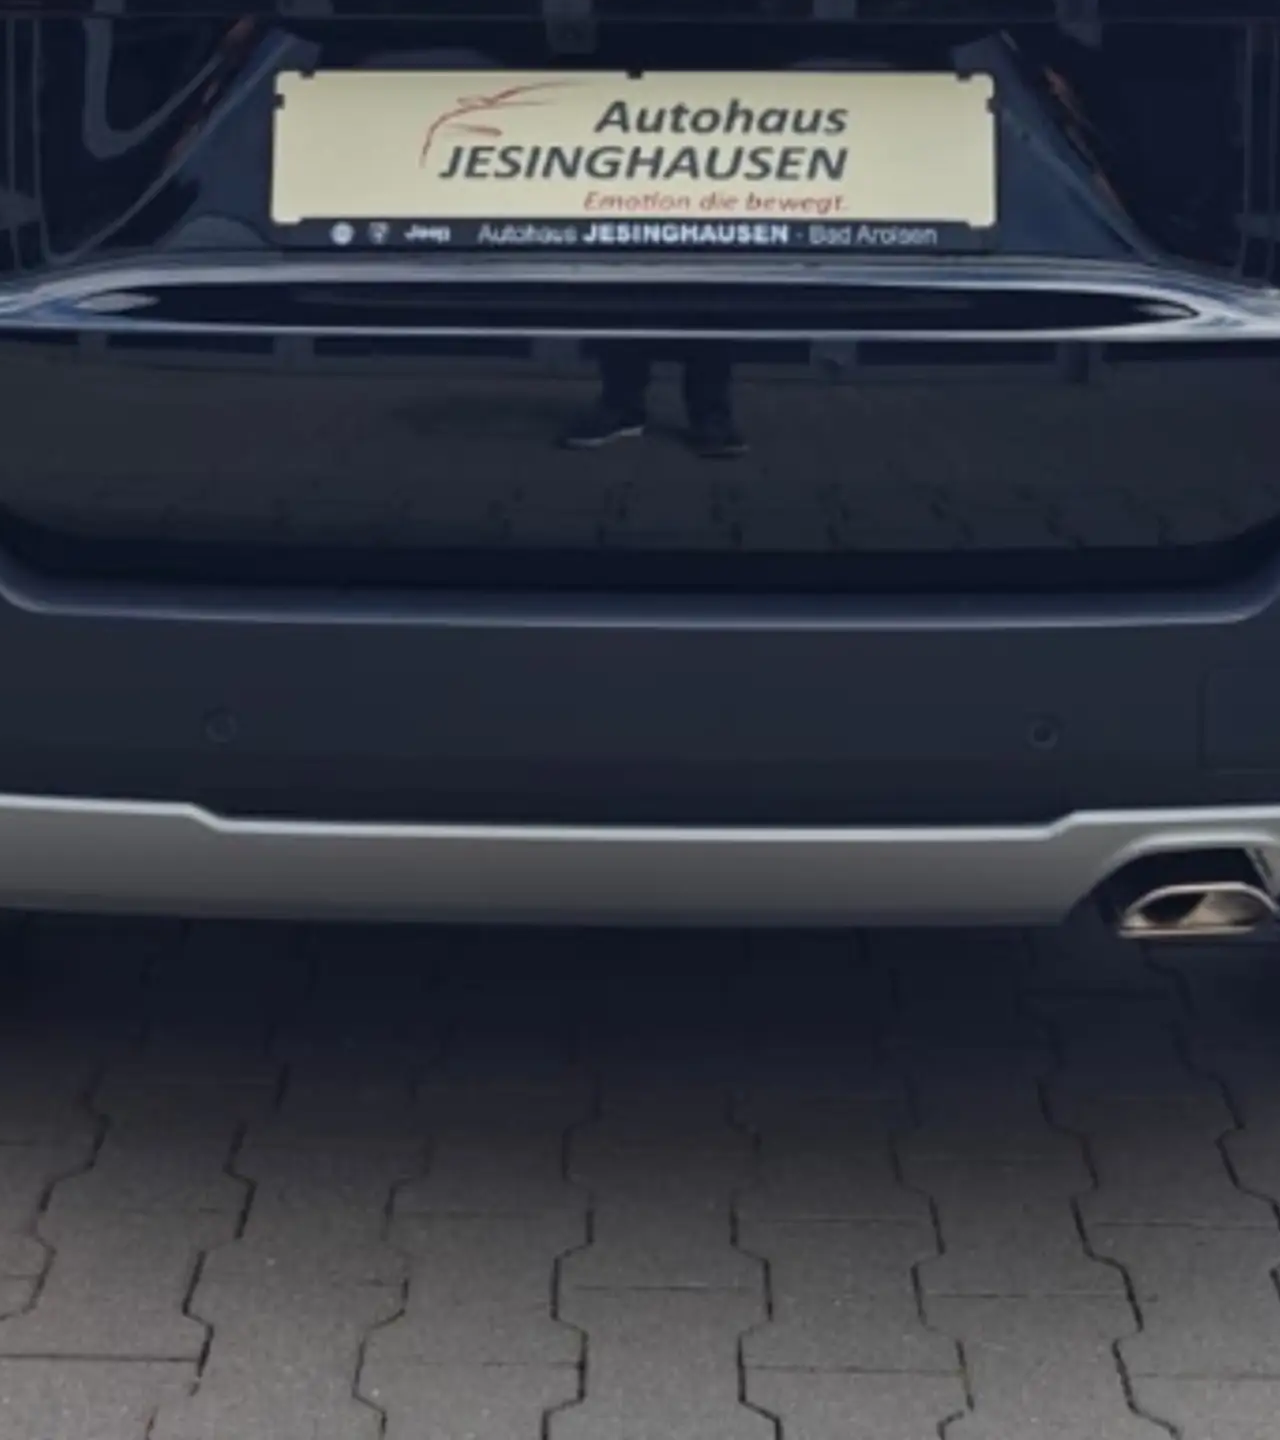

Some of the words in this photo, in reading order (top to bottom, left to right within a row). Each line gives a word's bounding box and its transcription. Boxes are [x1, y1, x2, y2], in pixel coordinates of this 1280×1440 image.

[594, 98, 848, 136] Autohaus
[439, 145, 848, 181] JESINGHAUSEN
[584, 191, 691, 212] Emotion
[699, 191, 738, 211] die
[746, 191, 850, 215] bewegt.
[477, 223, 577, 244] Autohaus
[583, 223, 789, 243] JESINGHAUSEN
[808, 224, 850, 244] Bad
[855, 223, 938, 245] Arolsen
